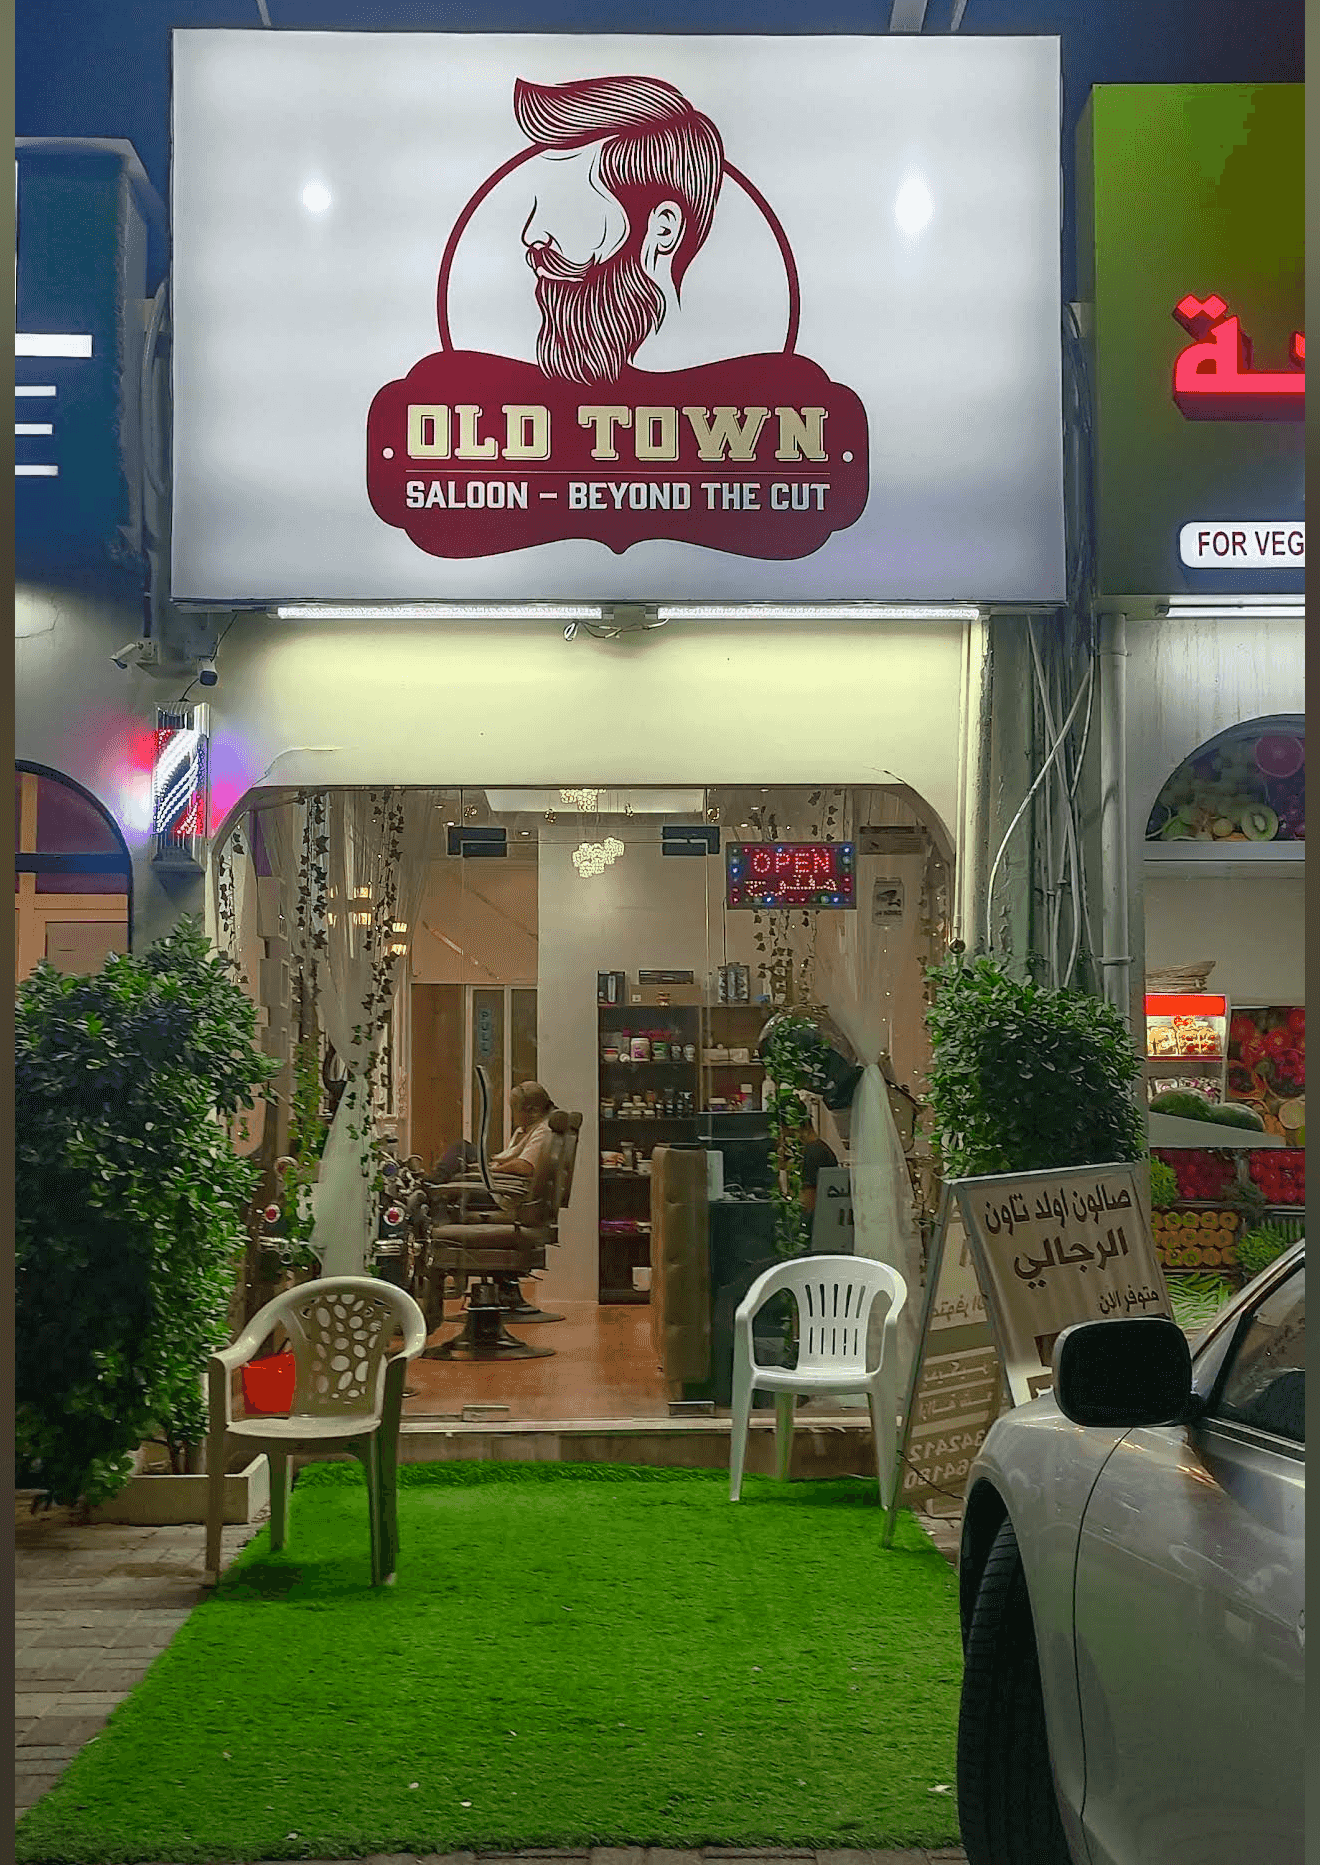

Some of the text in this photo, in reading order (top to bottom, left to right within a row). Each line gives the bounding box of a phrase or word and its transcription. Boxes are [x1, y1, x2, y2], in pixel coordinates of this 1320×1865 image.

[407, 404, 828, 461] OLD TOWN
[406, 480, 528, 510] SALOON
[569, 482, 691, 511] BEYOND
[702, 482, 761, 511] THE
[770, 482, 830, 511] CUT
[1197, 531, 1248, 557] FOR
[753, 852, 830, 873] OPEN
[744, 874, 838, 897] مفتوح
[985, 1184, 1132, 1236] صالون اولد تاون
[1014, 1226, 1129, 1289] الرجالي
[1124, 1284, 1160, 1312] متوفر
